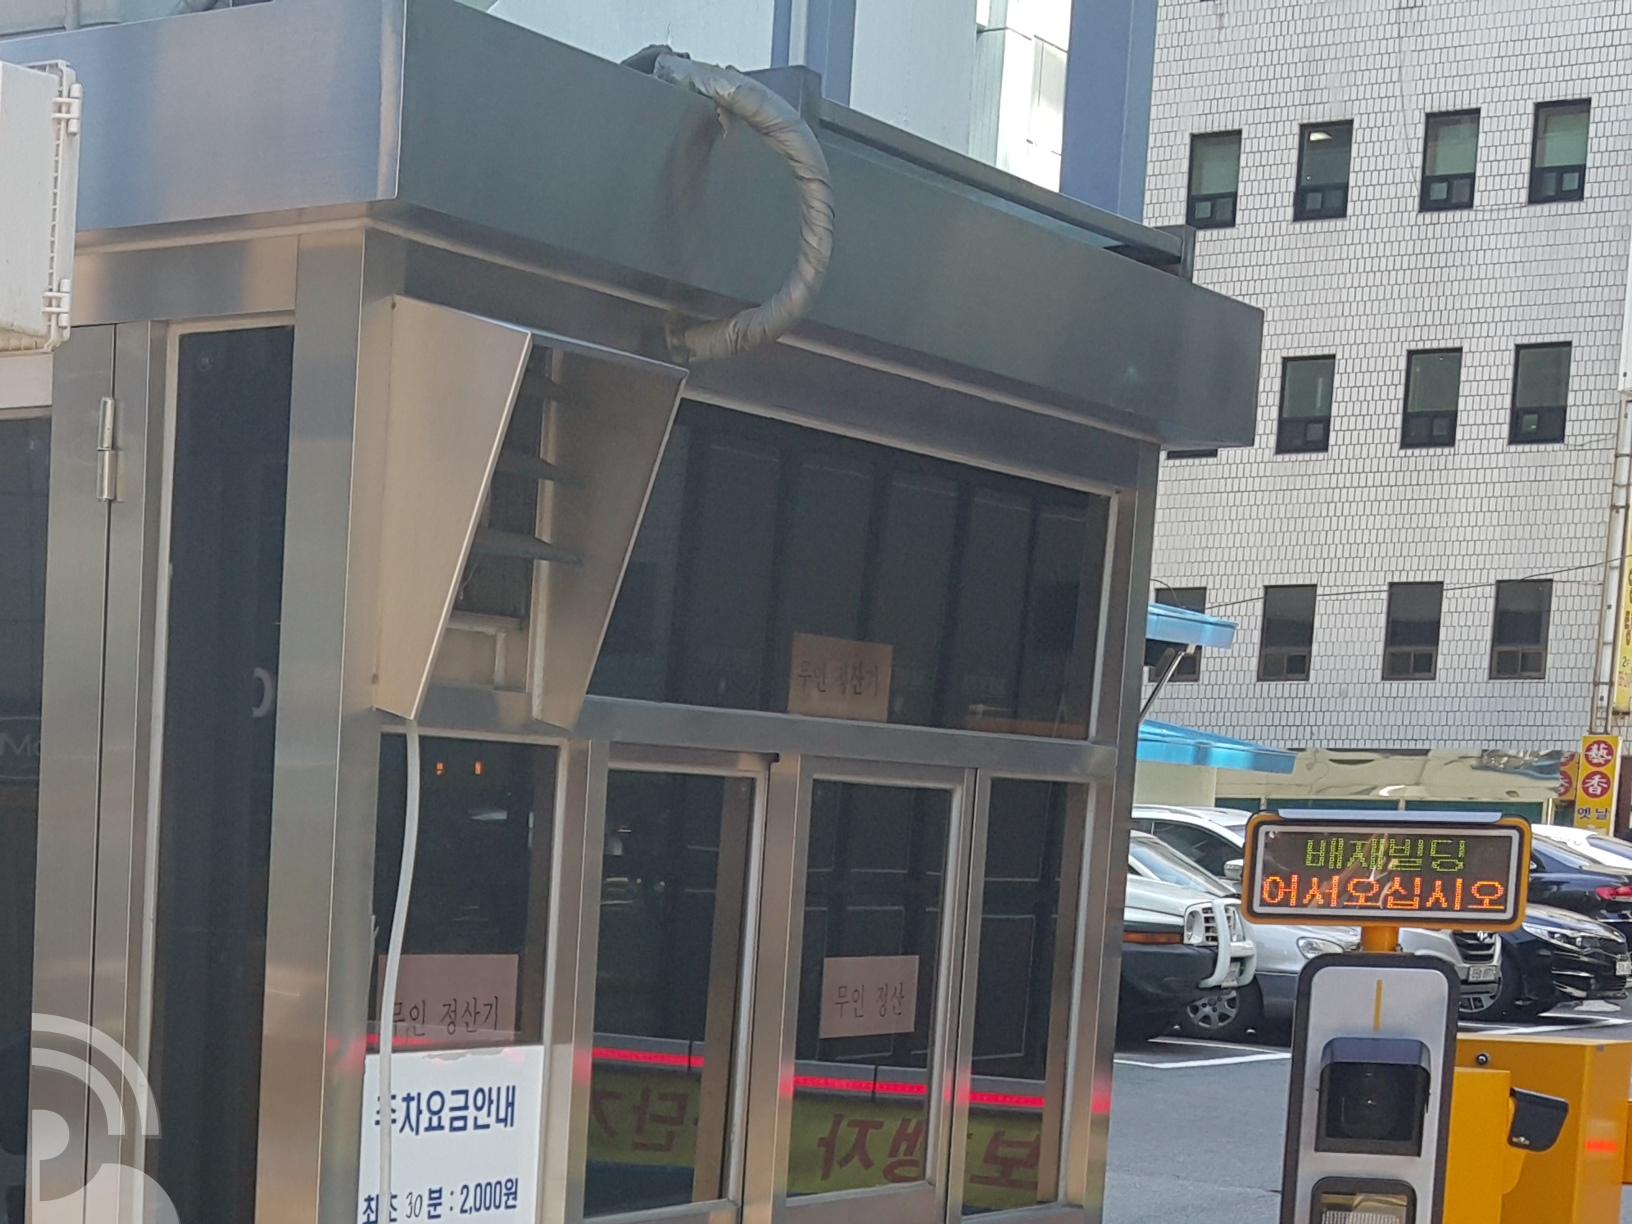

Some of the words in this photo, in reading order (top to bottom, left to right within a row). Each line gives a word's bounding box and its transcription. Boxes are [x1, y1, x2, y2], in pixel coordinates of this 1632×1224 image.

[1305, 837, 1466, 872] 배재빌딩
[1262, 874, 1505, 911] 어서오십시오
[439, 995, 500, 1035] 정산기
[834, 984, 865, 1019] 무인
[459, 1177, 519, 1215] 2,000원
